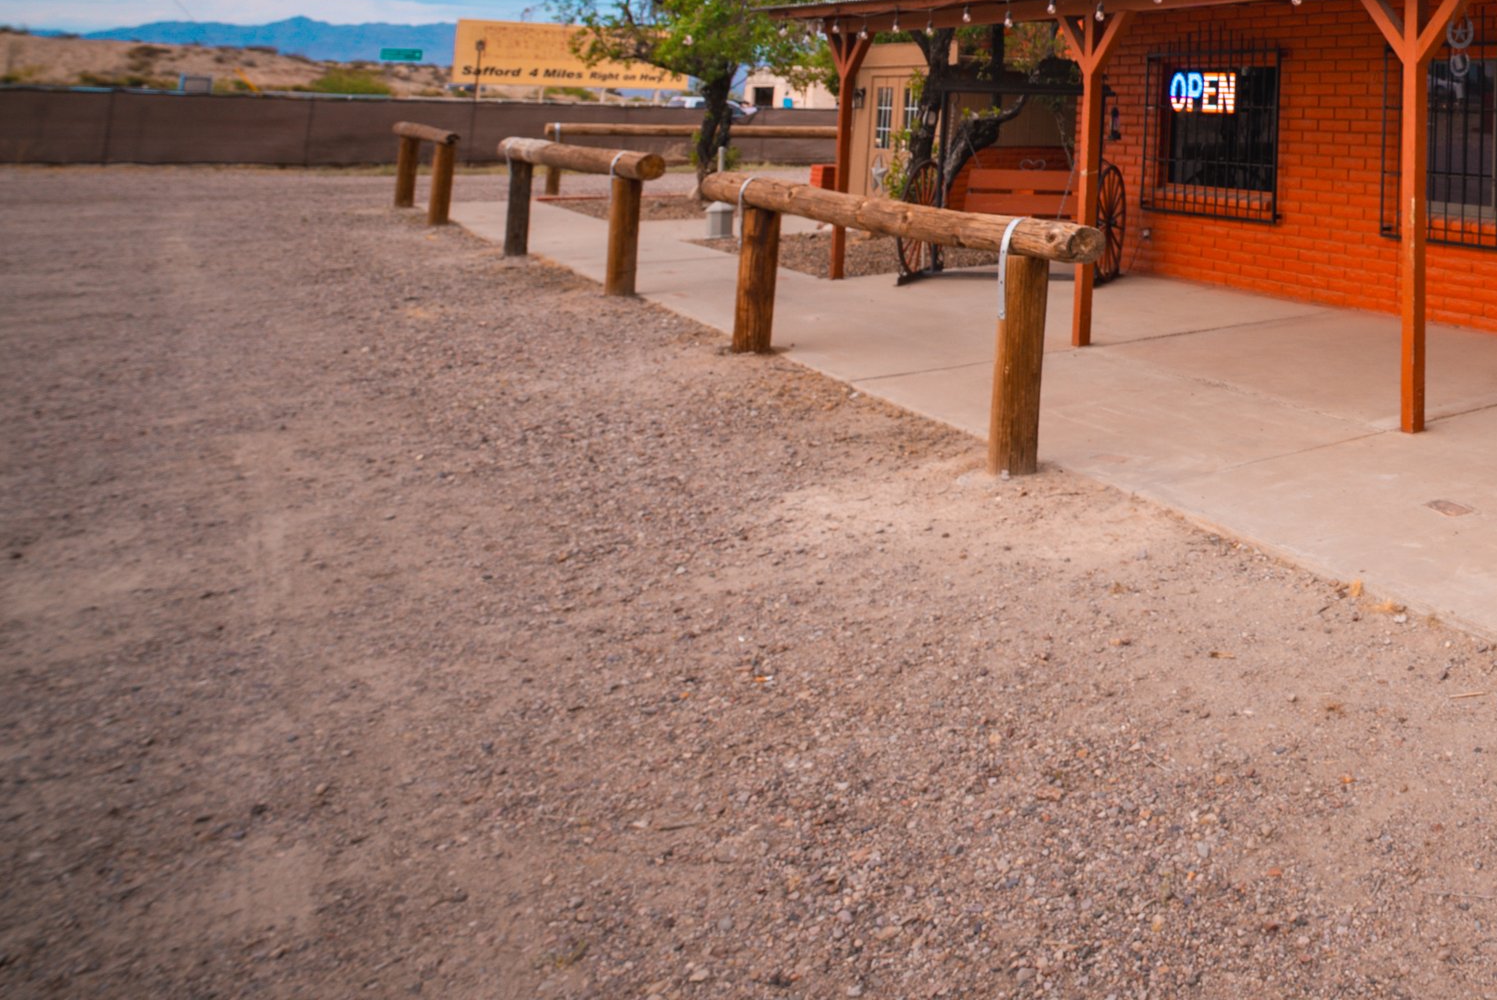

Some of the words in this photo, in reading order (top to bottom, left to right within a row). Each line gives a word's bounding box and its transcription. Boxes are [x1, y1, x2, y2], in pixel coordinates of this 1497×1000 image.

[462, 64, 521, 78] Safford
[528, 67, 539, 78] 4
[543, 69, 583, 79] Miles
[590, 71, 619, 82] Right
[1170, 72, 1236, 114] OPEN
